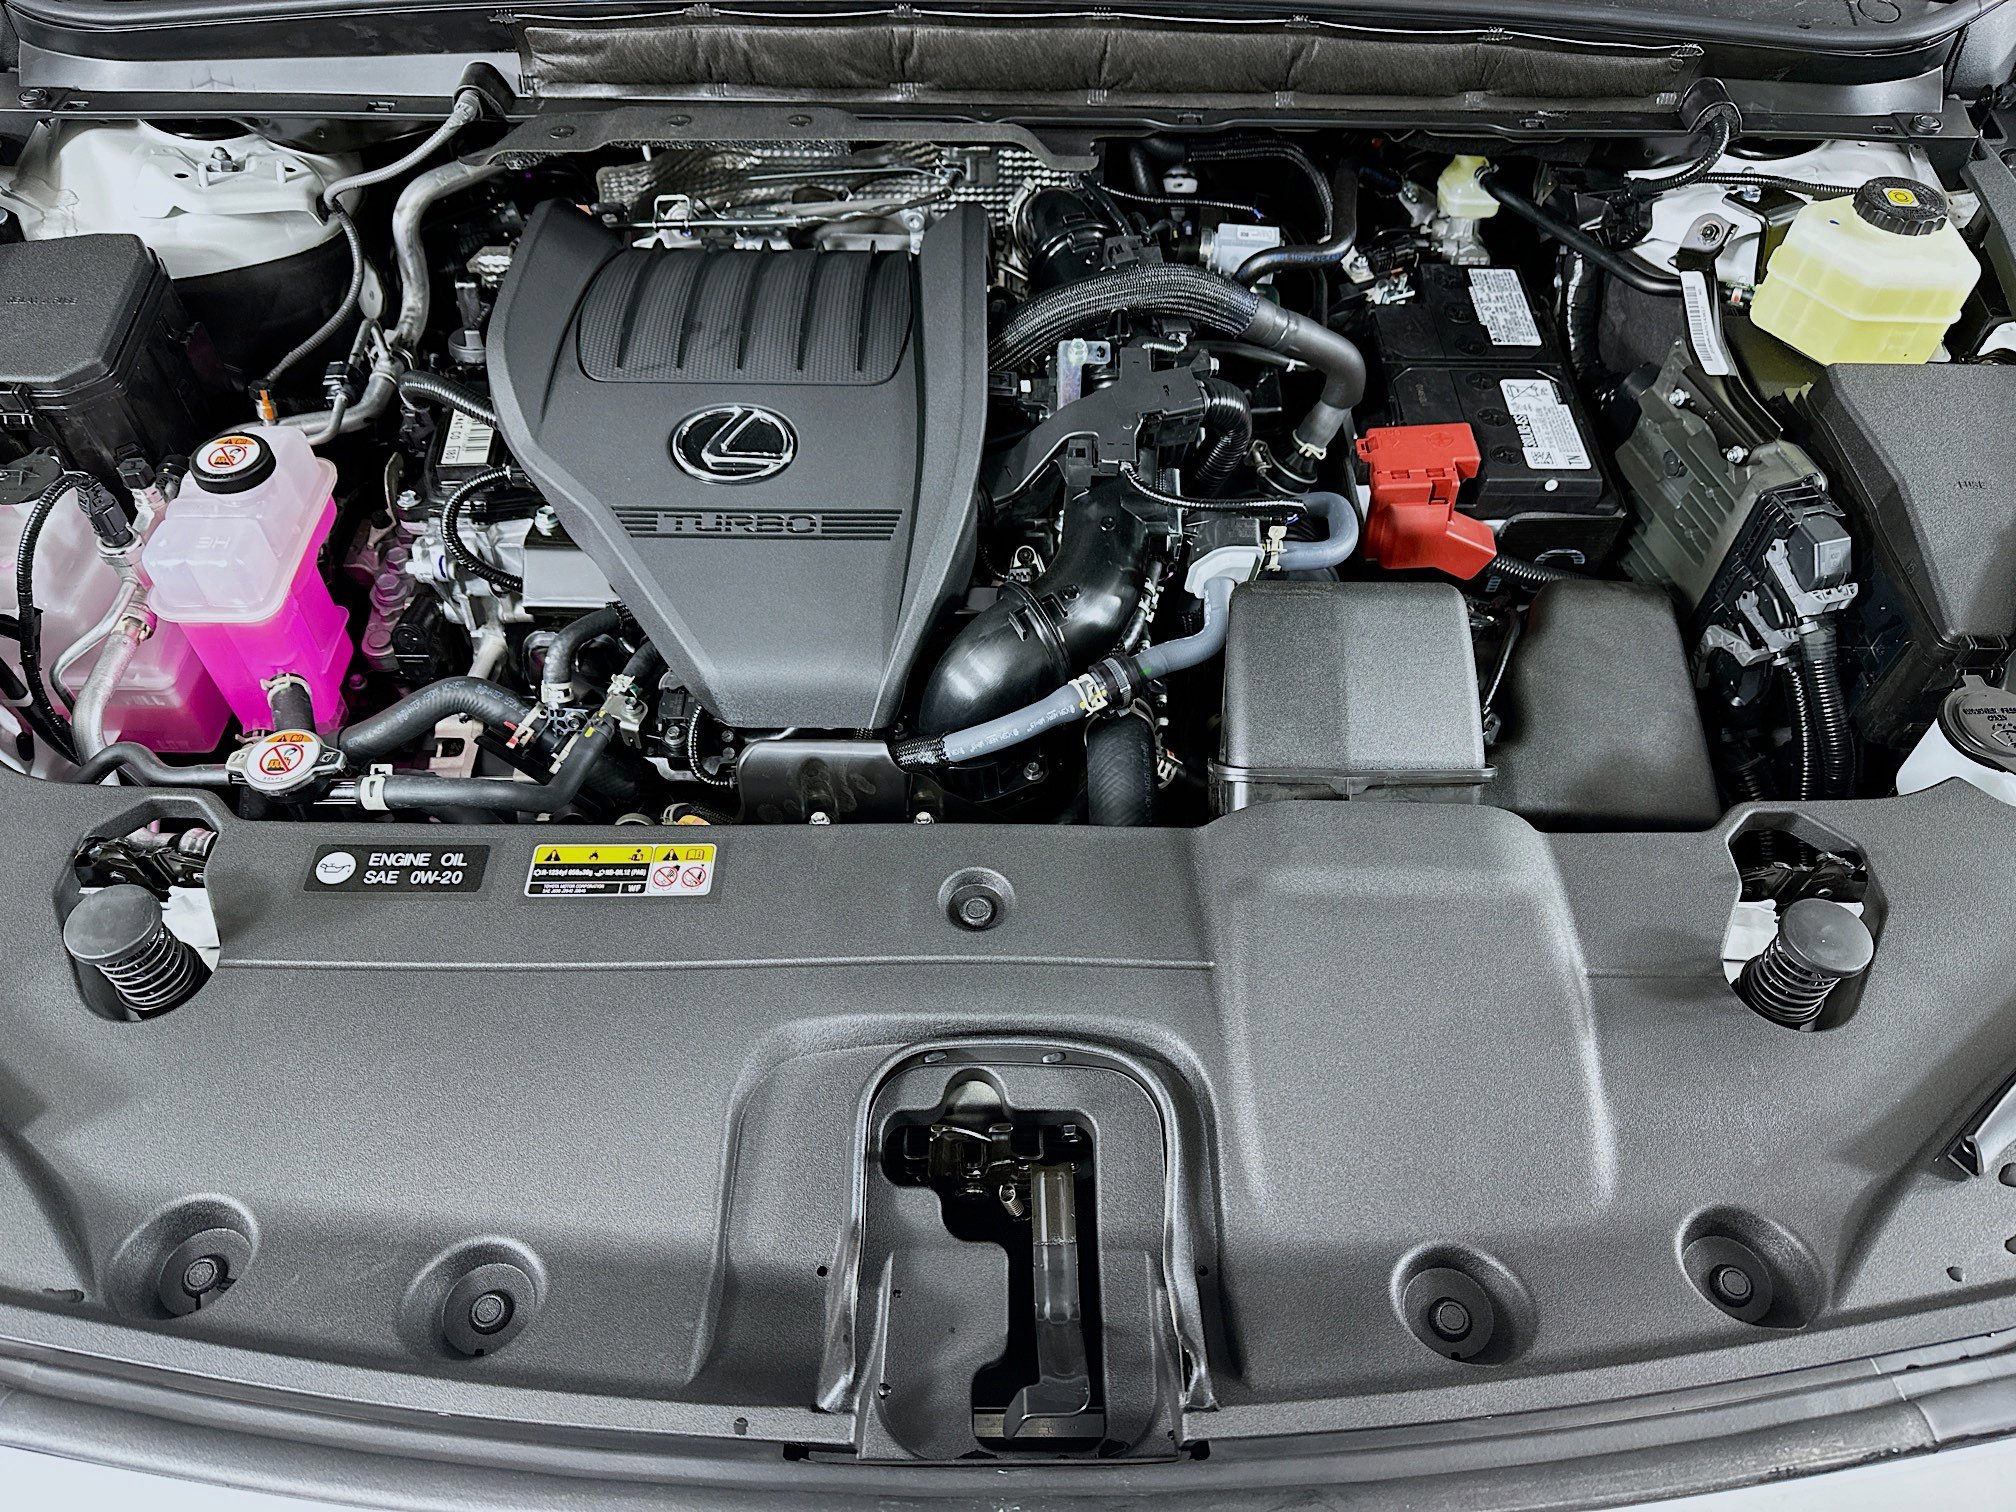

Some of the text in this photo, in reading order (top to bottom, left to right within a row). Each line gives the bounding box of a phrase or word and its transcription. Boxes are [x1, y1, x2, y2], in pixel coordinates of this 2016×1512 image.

[661, 511, 818, 534] TURBO
[368, 853, 467, 867] ENGINE OIL
[363, 870, 464, 885] SAE 0W-20
